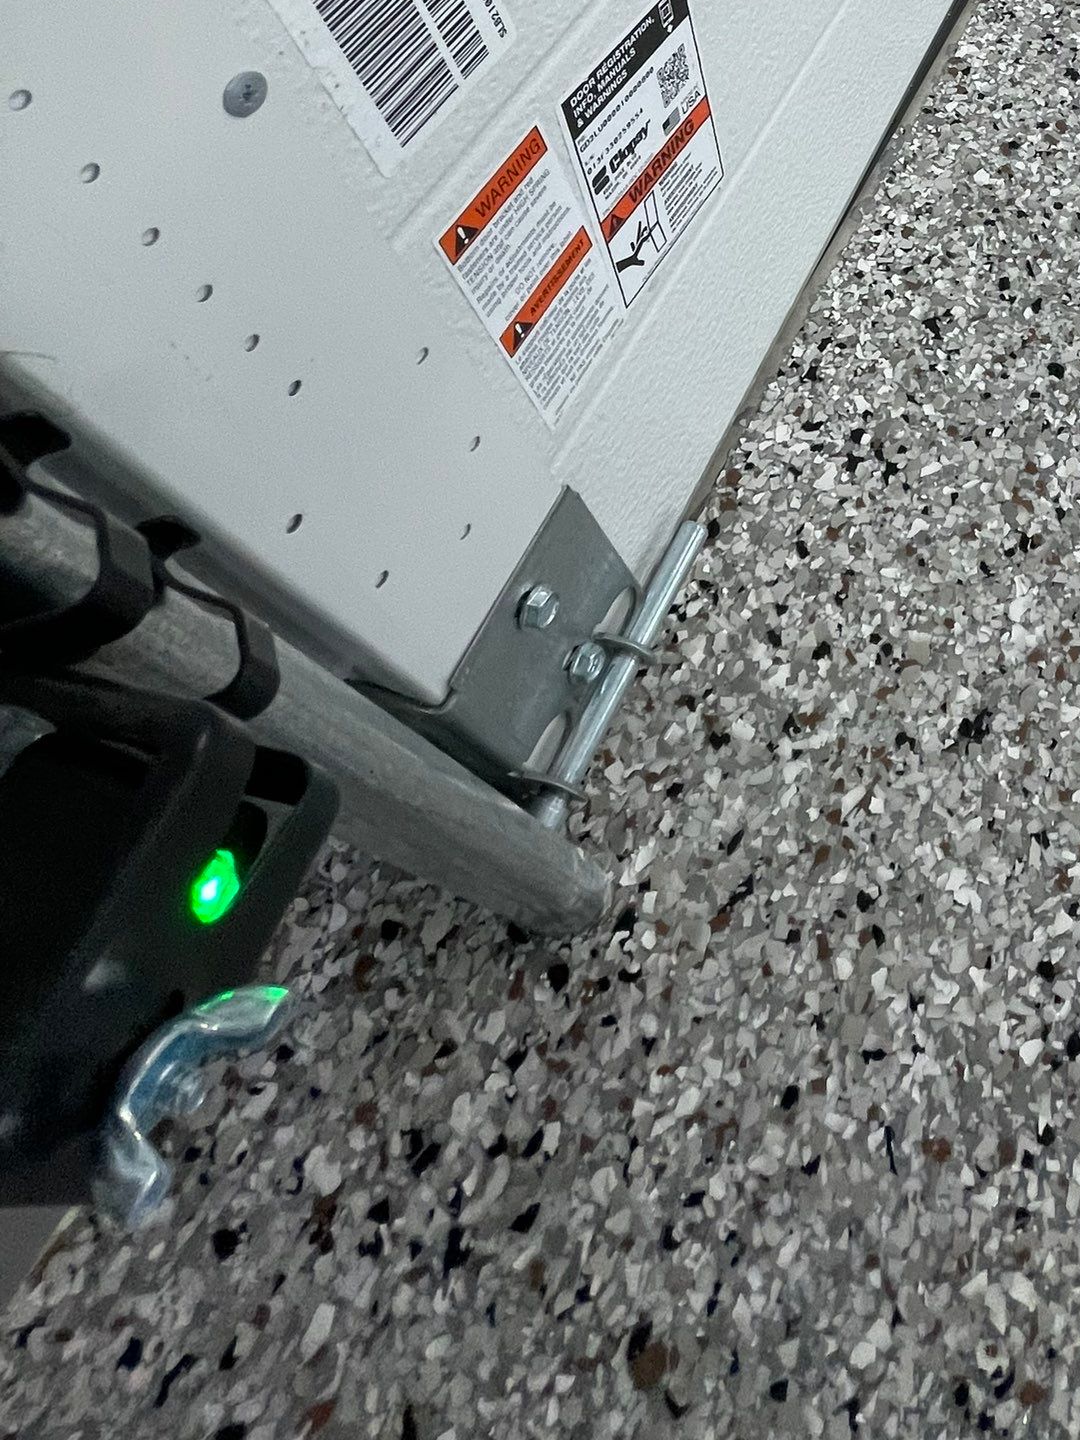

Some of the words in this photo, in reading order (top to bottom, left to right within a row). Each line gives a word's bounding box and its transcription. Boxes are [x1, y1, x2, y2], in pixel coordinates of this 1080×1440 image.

[569, 77, 595, 107] DOOR
[573, 92, 596, 118] INFO,
[596, 47, 635, 92] MANUALS
[576, 117, 584, 127] &
[584, 68, 627, 118] WARNINGS
[681, 90, 701, 114] USA
[608, 118, 650, 174] Clopay
[628, 118, 694, 203] WARNING
[474, 137, 541, 217] WARNING
[512, 193, 530, 215] HIGH
[528, 168, 550, 196] SPRING
[466, 252, 493, 286] TENSION
[514, 281, 525, 295] DO
[523, 266, 535, 283] NOT
[530, 238, 583, 316] AVERTISSEMENT
